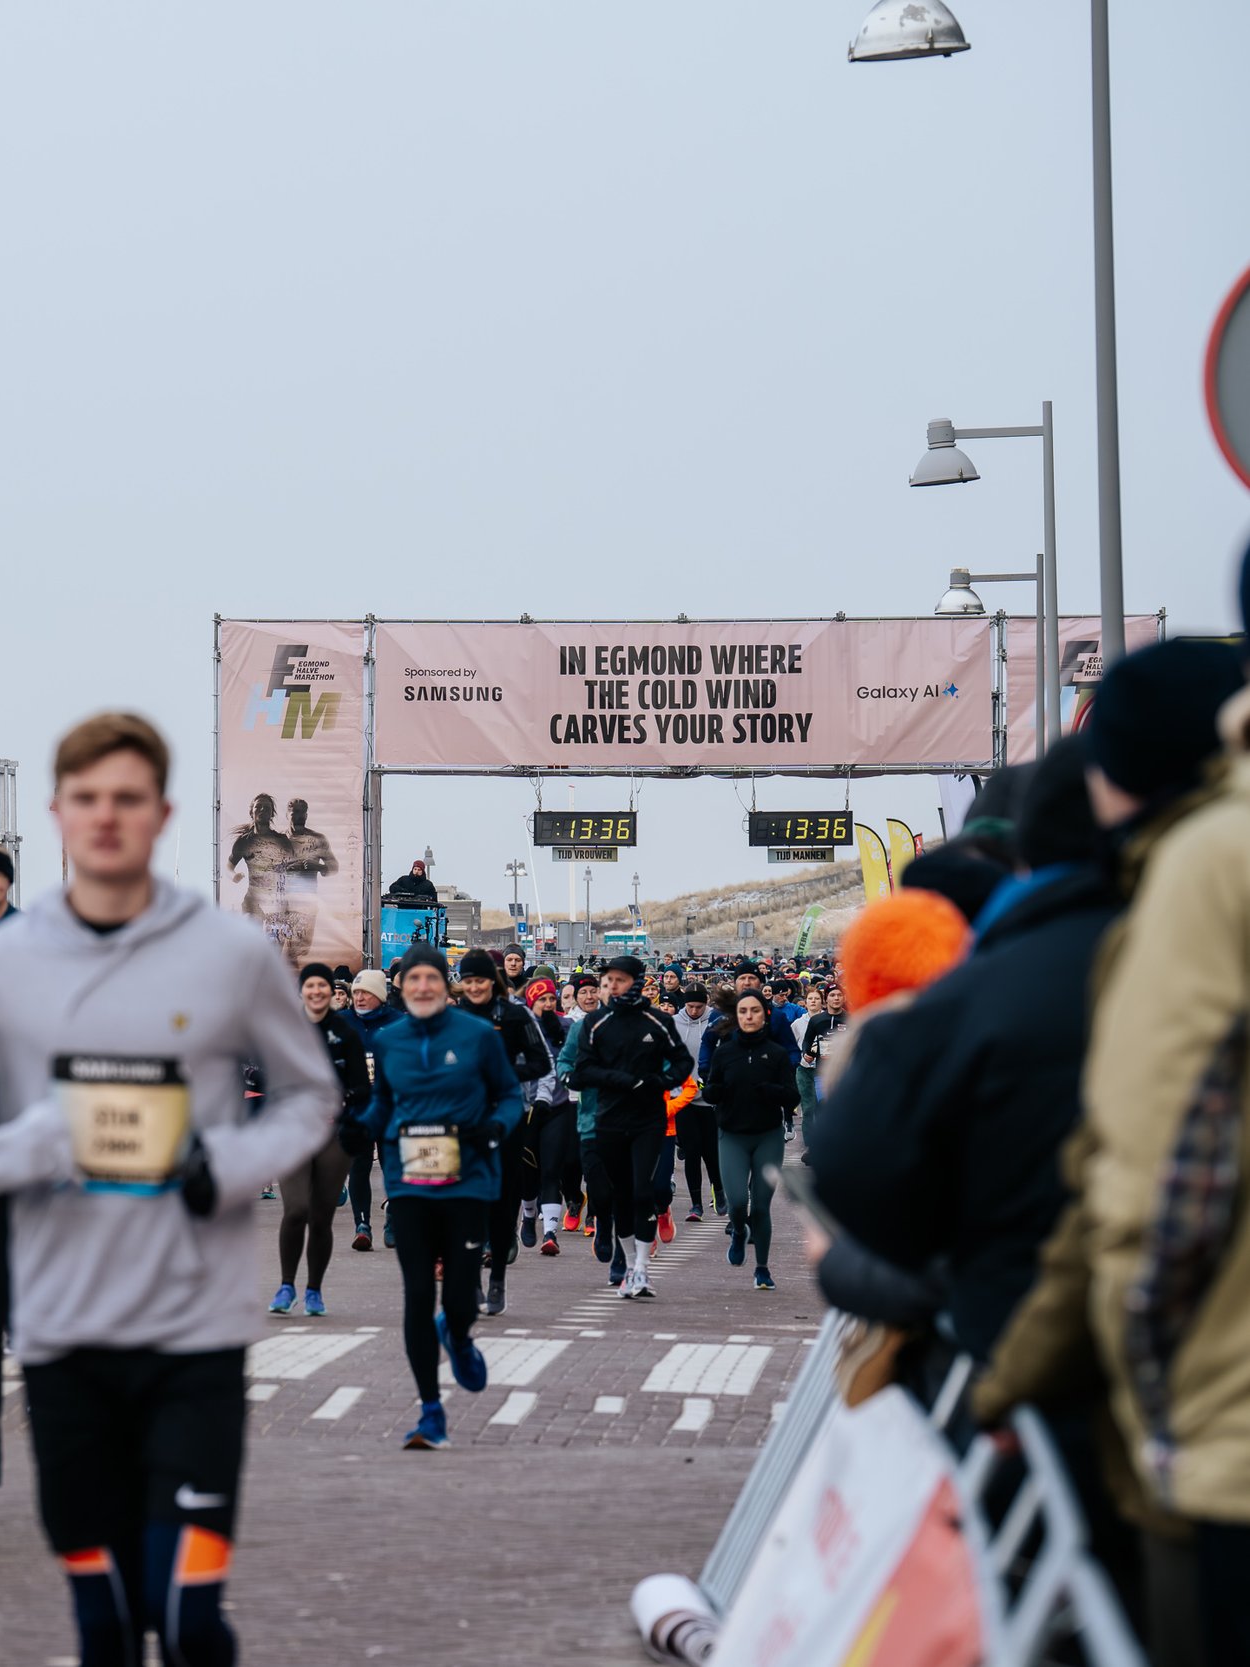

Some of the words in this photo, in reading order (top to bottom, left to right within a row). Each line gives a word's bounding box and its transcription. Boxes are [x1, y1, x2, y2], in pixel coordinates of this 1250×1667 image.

[559, 645, 586, 675] IN
[595, 645, 702, 676] EGMOND
[710, 644, 803, 674] WHERE
[404, 668, 462, 679] Sponsored
[463, 668, 477, 679] by
[404, 686, 503, 702] SAMSUNG
[584, 680, 629, 710] THE
[638, 679, 697, 710] COLD
[705, 679, 777, 709] WIND
[856, 686, 919, 702] Galaxy
[923, 684, 939, 698] AI
[550, 714, 648, 744] CARVES
[655, 714, 725, 744] YOUR
[732, 713, 813, 744] STORY
[557, 850, 572, 859] TIJD
[574, 850, 613, 859] VROUWEN
[776, 851, 791, 860] TIJD
[792, 851, 827, 860] MANNEN
